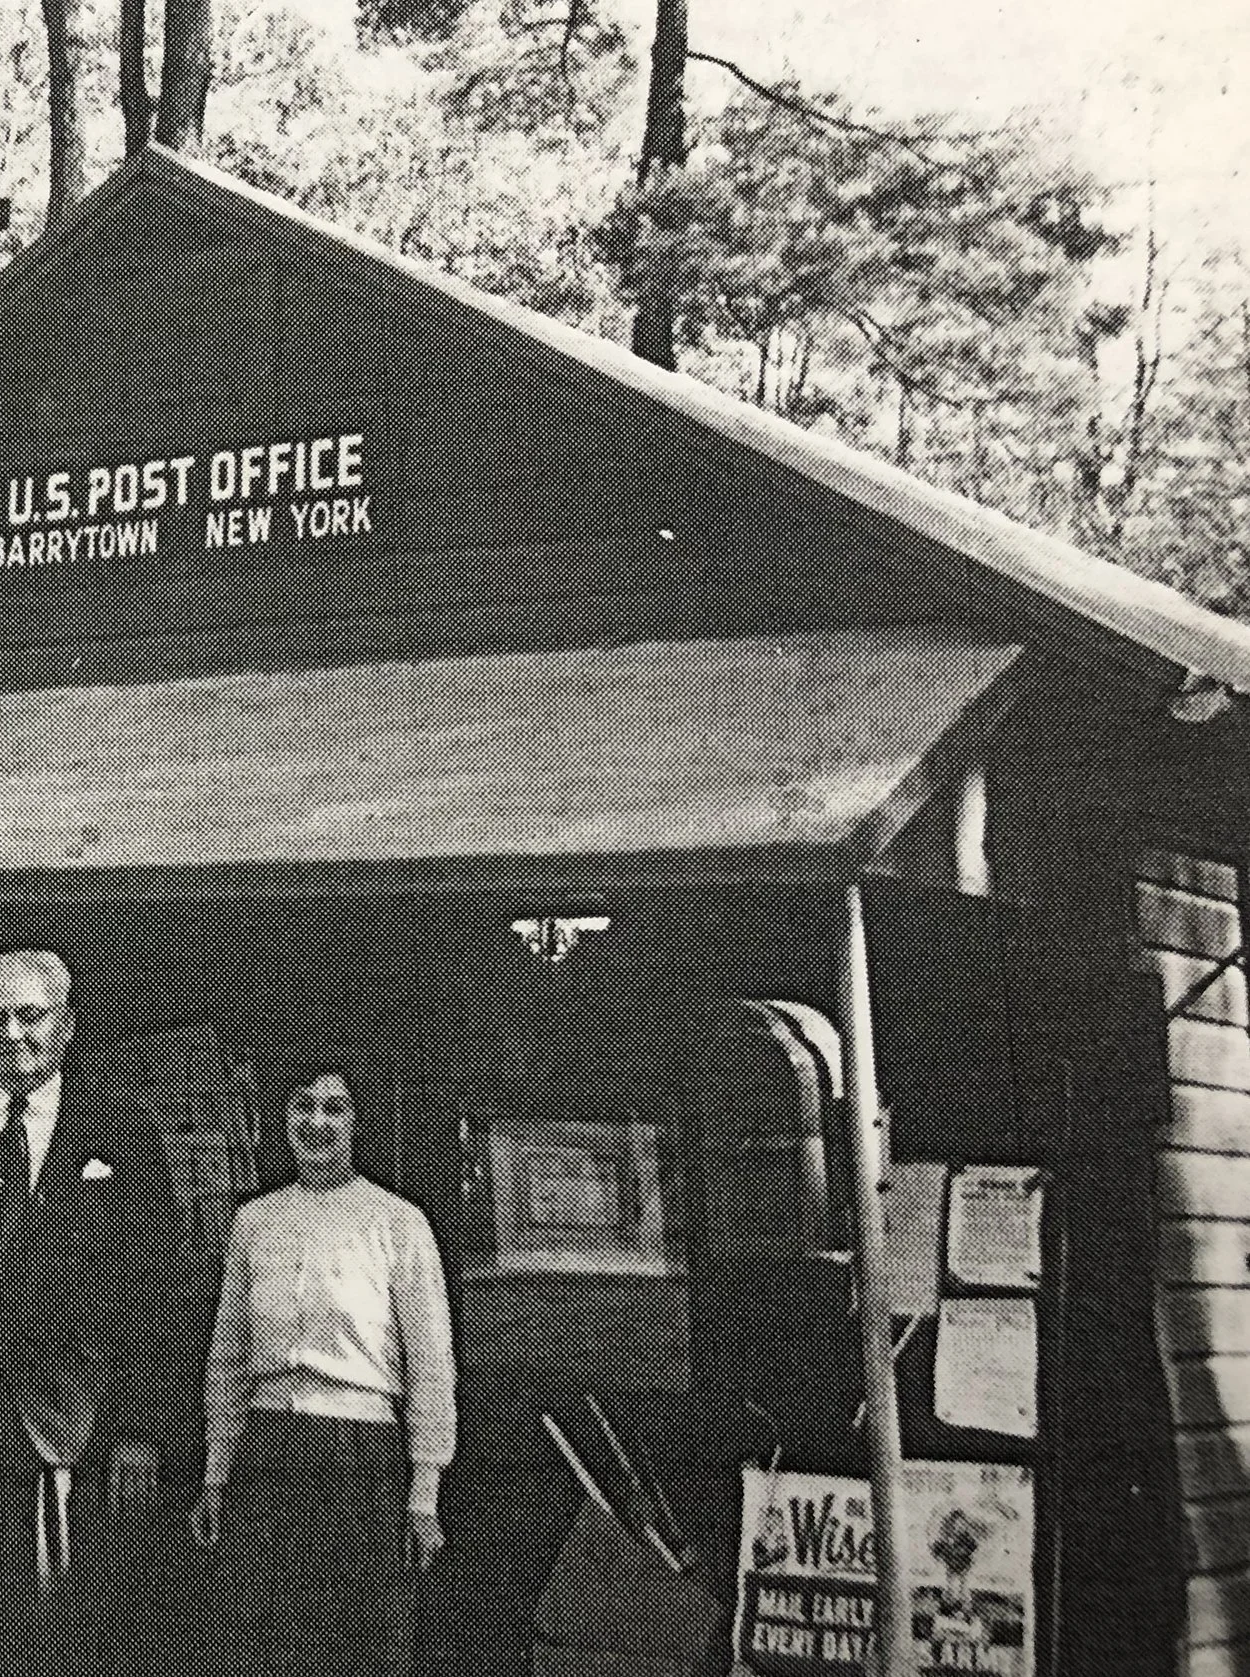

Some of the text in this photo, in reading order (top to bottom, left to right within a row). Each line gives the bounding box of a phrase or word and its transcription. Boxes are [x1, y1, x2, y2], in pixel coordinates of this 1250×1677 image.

[8, 433, 364, 525] U.S. POST OFFICE
[205, 507, 273, 549] NEW
[289, 496, 372, 540] YORK
[757, 1587, 875, 1628] MAIL EARLY
[752, 1622, 815, 1658] EVERY
